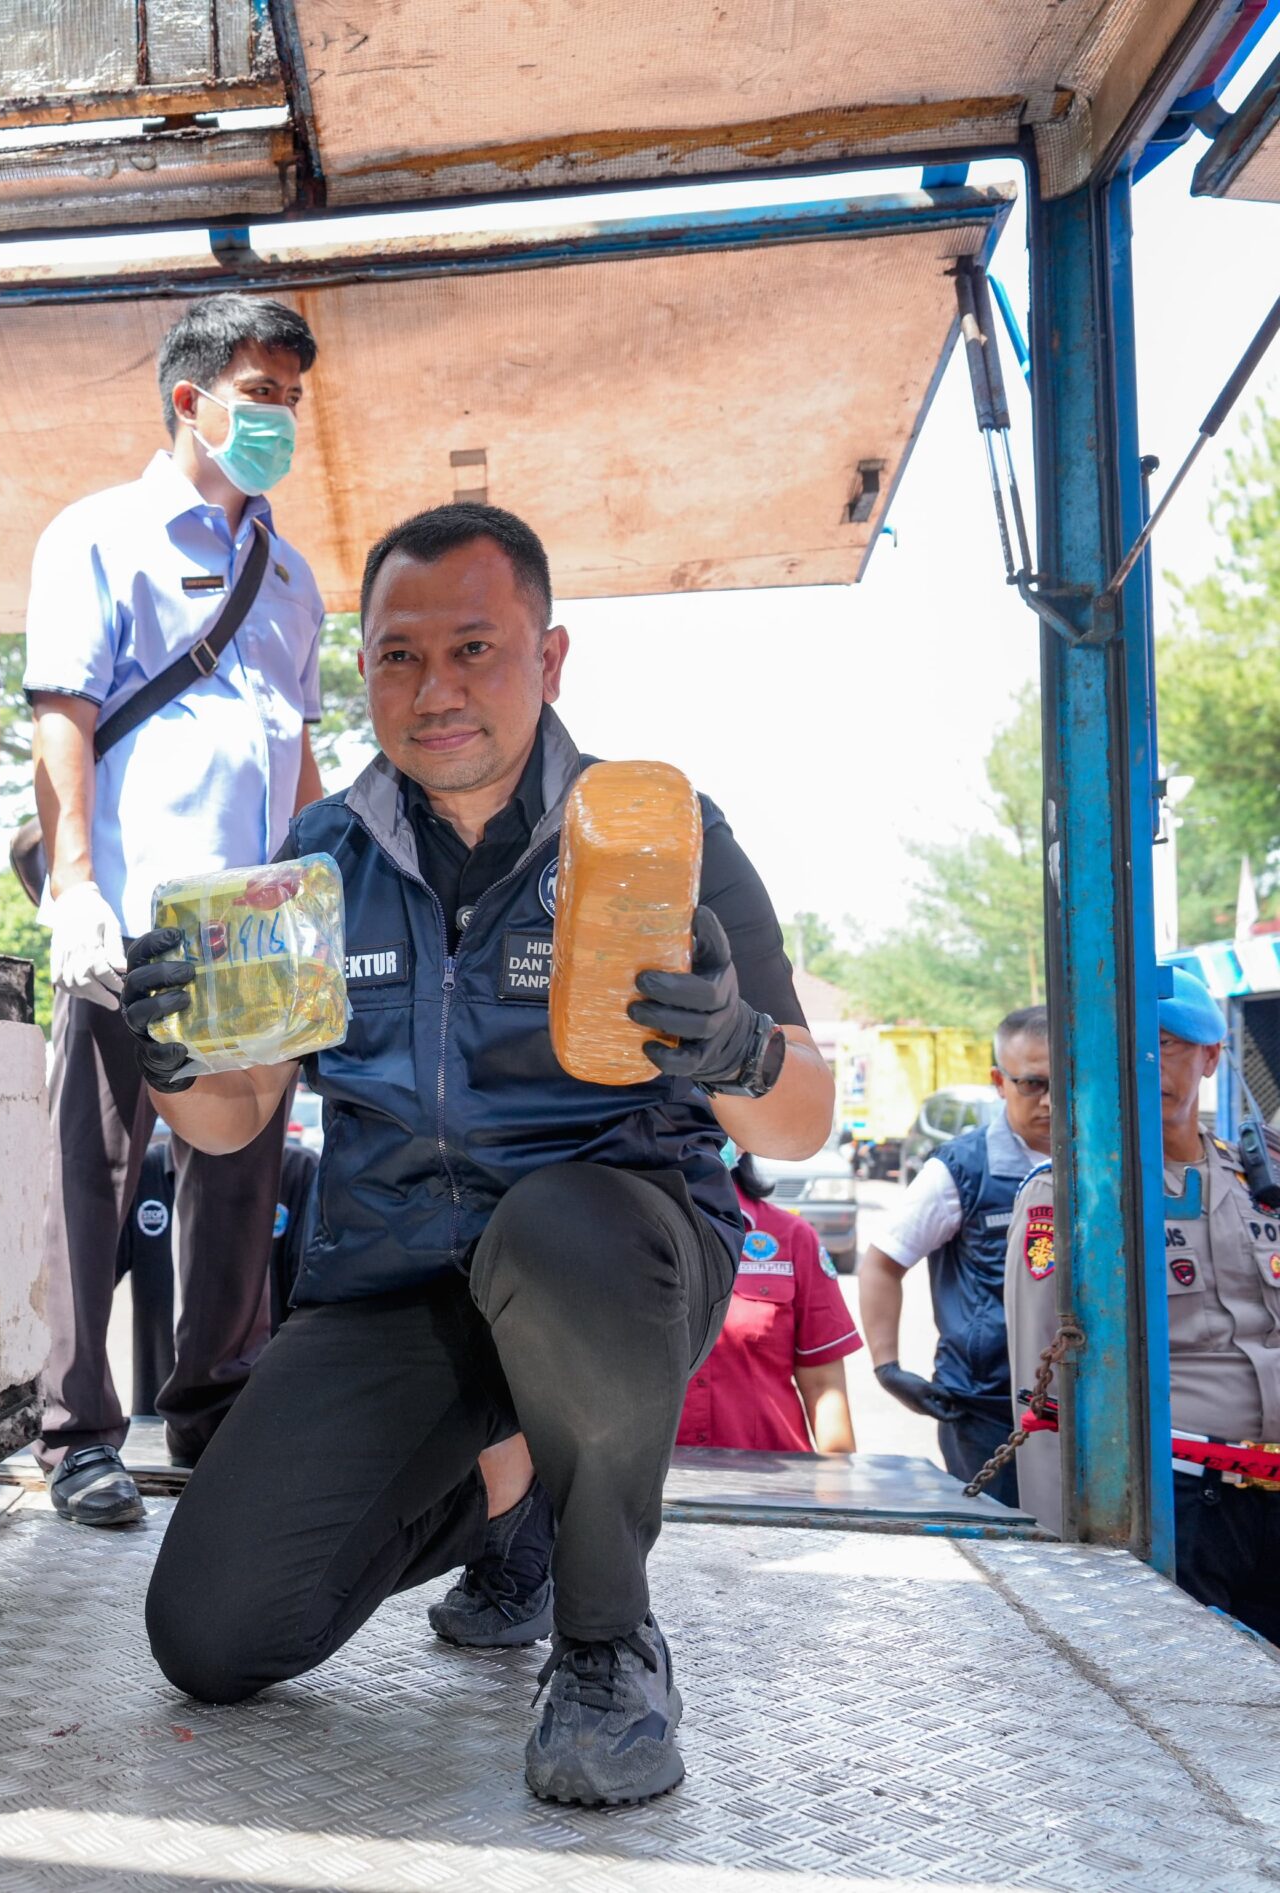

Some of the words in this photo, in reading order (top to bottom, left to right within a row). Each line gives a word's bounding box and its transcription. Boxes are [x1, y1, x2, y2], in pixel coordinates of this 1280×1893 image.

[509, 956, 543, 971] DAN
[508, 973, 551, 989] TANP
[1249, 1222, 1280, 1242] PO
